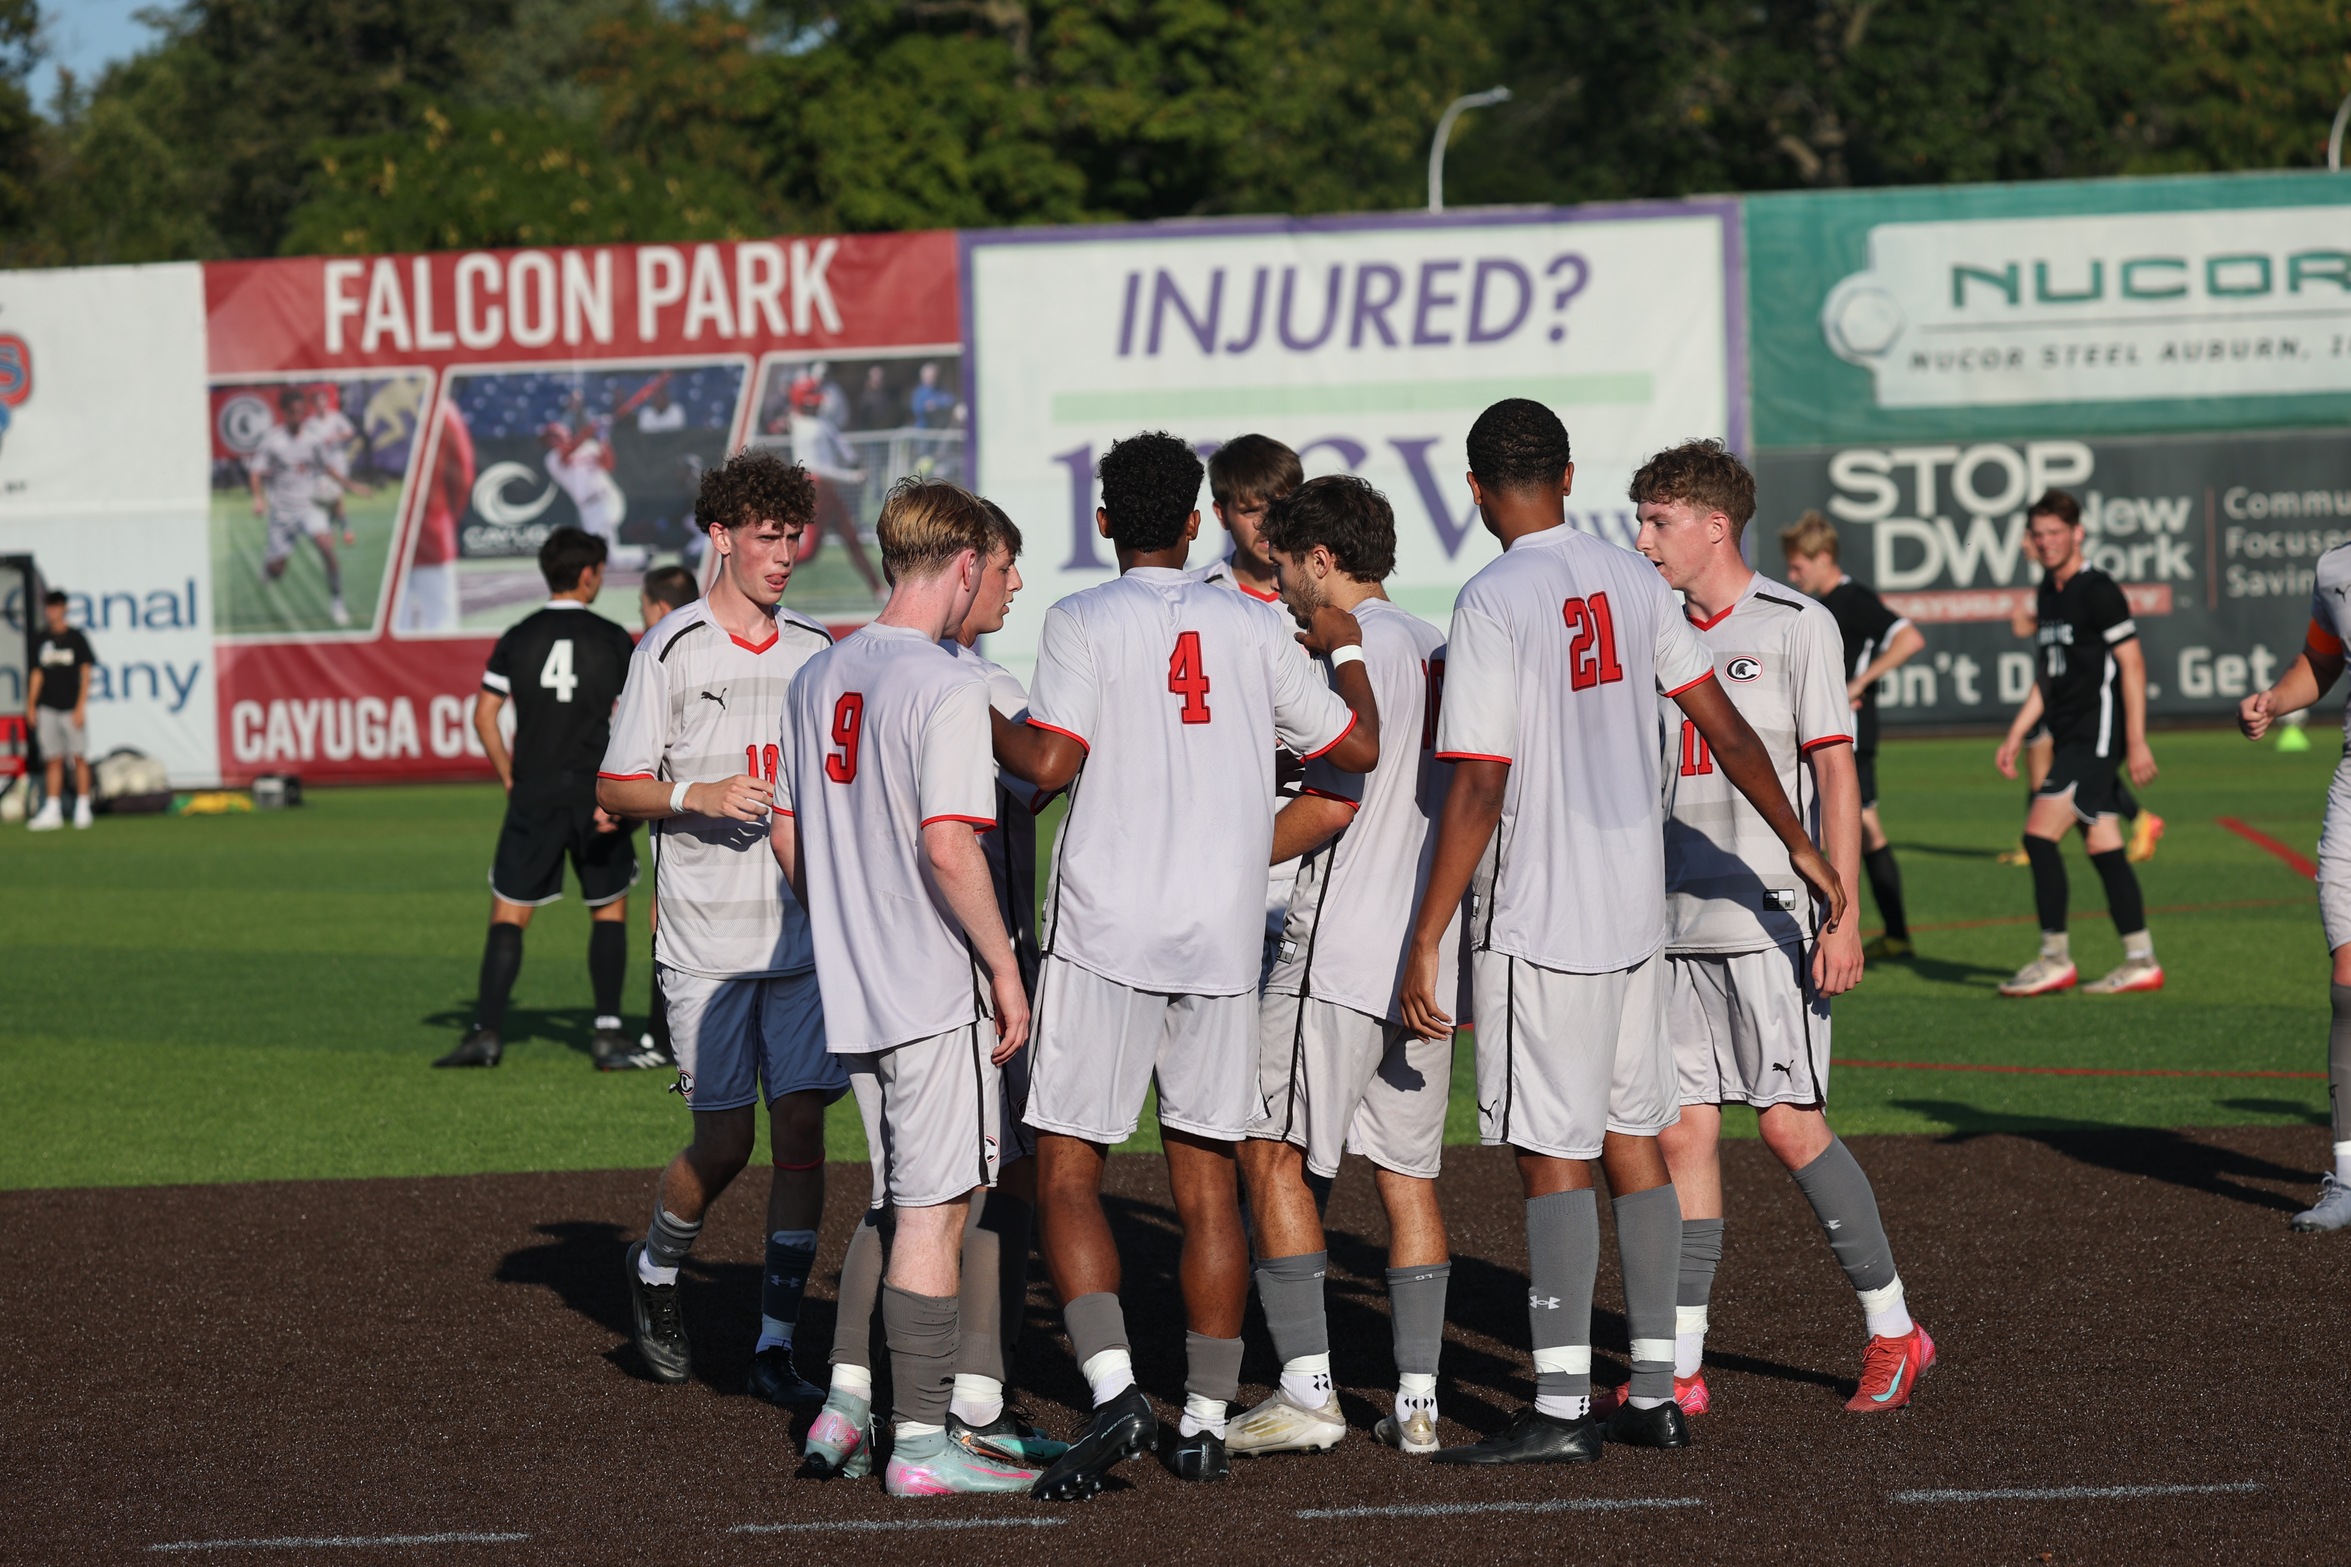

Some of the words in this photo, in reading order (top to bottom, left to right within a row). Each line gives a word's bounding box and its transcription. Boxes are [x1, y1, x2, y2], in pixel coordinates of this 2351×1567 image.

[323, 249, 615, 354] FALCON
[636, 238, 845, 342] PARK
[1116, 252, 1592, 358] INJURED?
[1949, 247, 2351, 308] NUCOR
[1908, 346, 2025, 374] NUCOR
[2040, 341, 2142, 369] STEEL
[2160, 336, 2311, 363] AUBURN,
[1827, 440, 2096, 524] STOP
[1872, 513, 2046, 591] DW
[2225, 526, 2351, 559] Focuse
[539, 639, 578, 703] 4
[1563, 590, 1624, 693] 21
[2177, 644, 2277, 698] Get
[1168, 630, 1211, 725] 4
[230, 697, 422, 764] CAYUGA
[825, 692, 864, 785] 9
[1681, 719, 1713, 776] 11
[746, 743, 779, 790] 18
